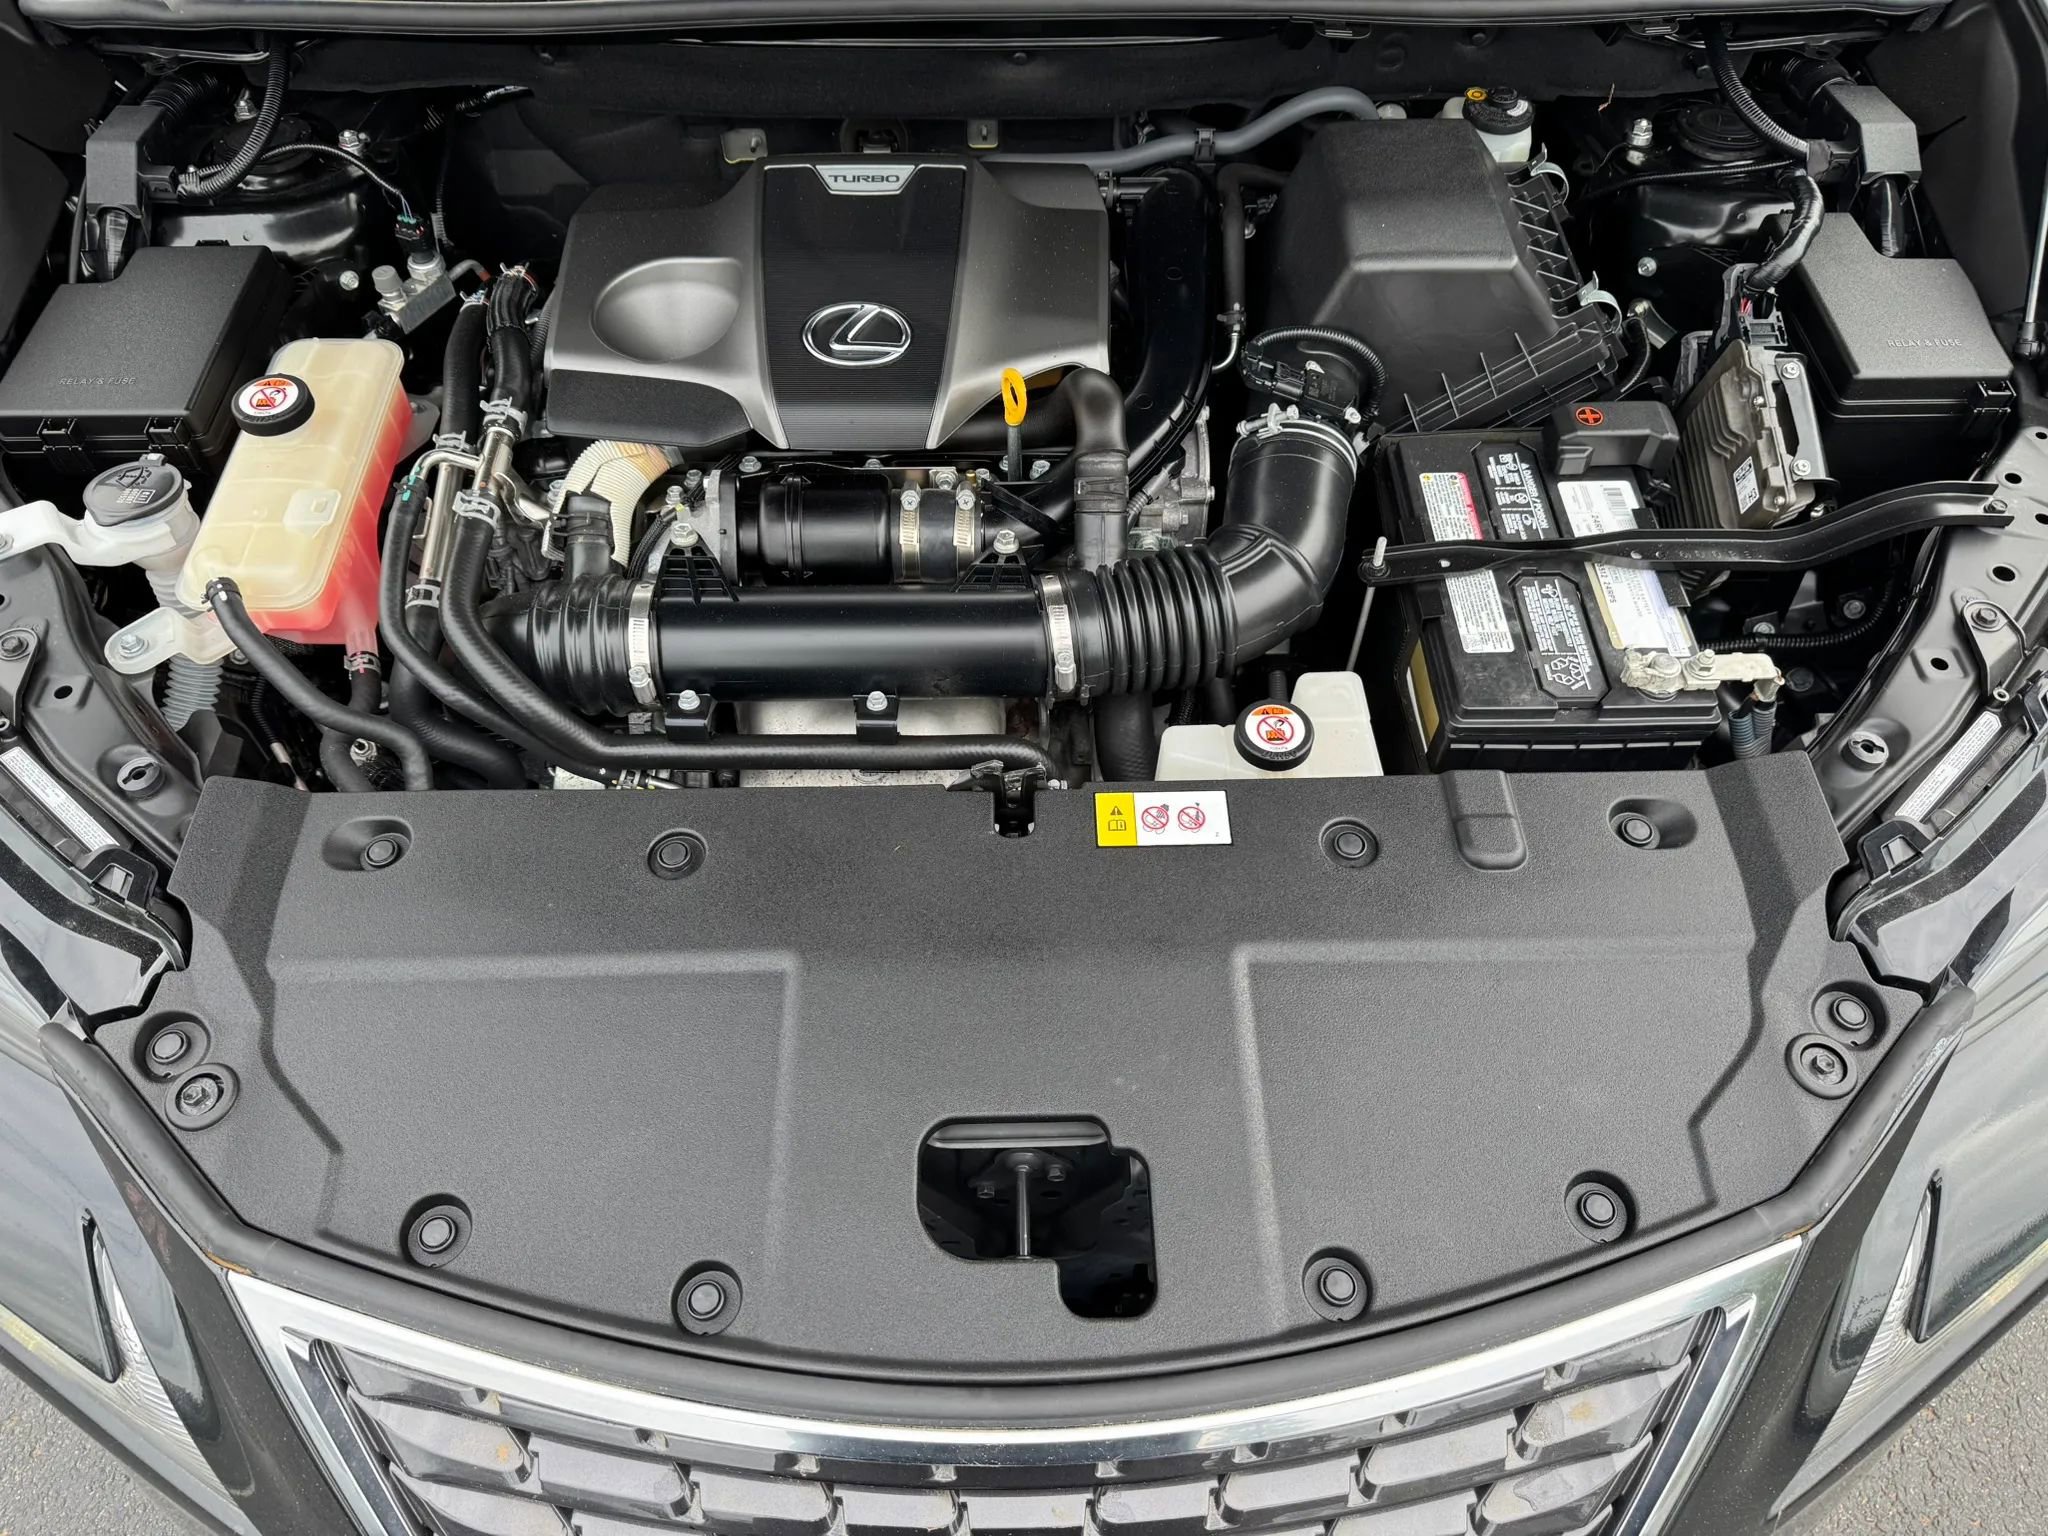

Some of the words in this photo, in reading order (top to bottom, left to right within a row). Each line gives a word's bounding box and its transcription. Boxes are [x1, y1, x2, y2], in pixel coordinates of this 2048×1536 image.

[828, 174, 900, 184] TURBO
[1886, 339, 1921, 348] RELAY
[1933, 338, 1962, 347] FUSE
[58, 377, 95, 385] RELAY
[107, 377, 137, 385] FUSE
[1521, 468, 1539, 499] DANGER
[1532, 500, 1549, 530] POISON
